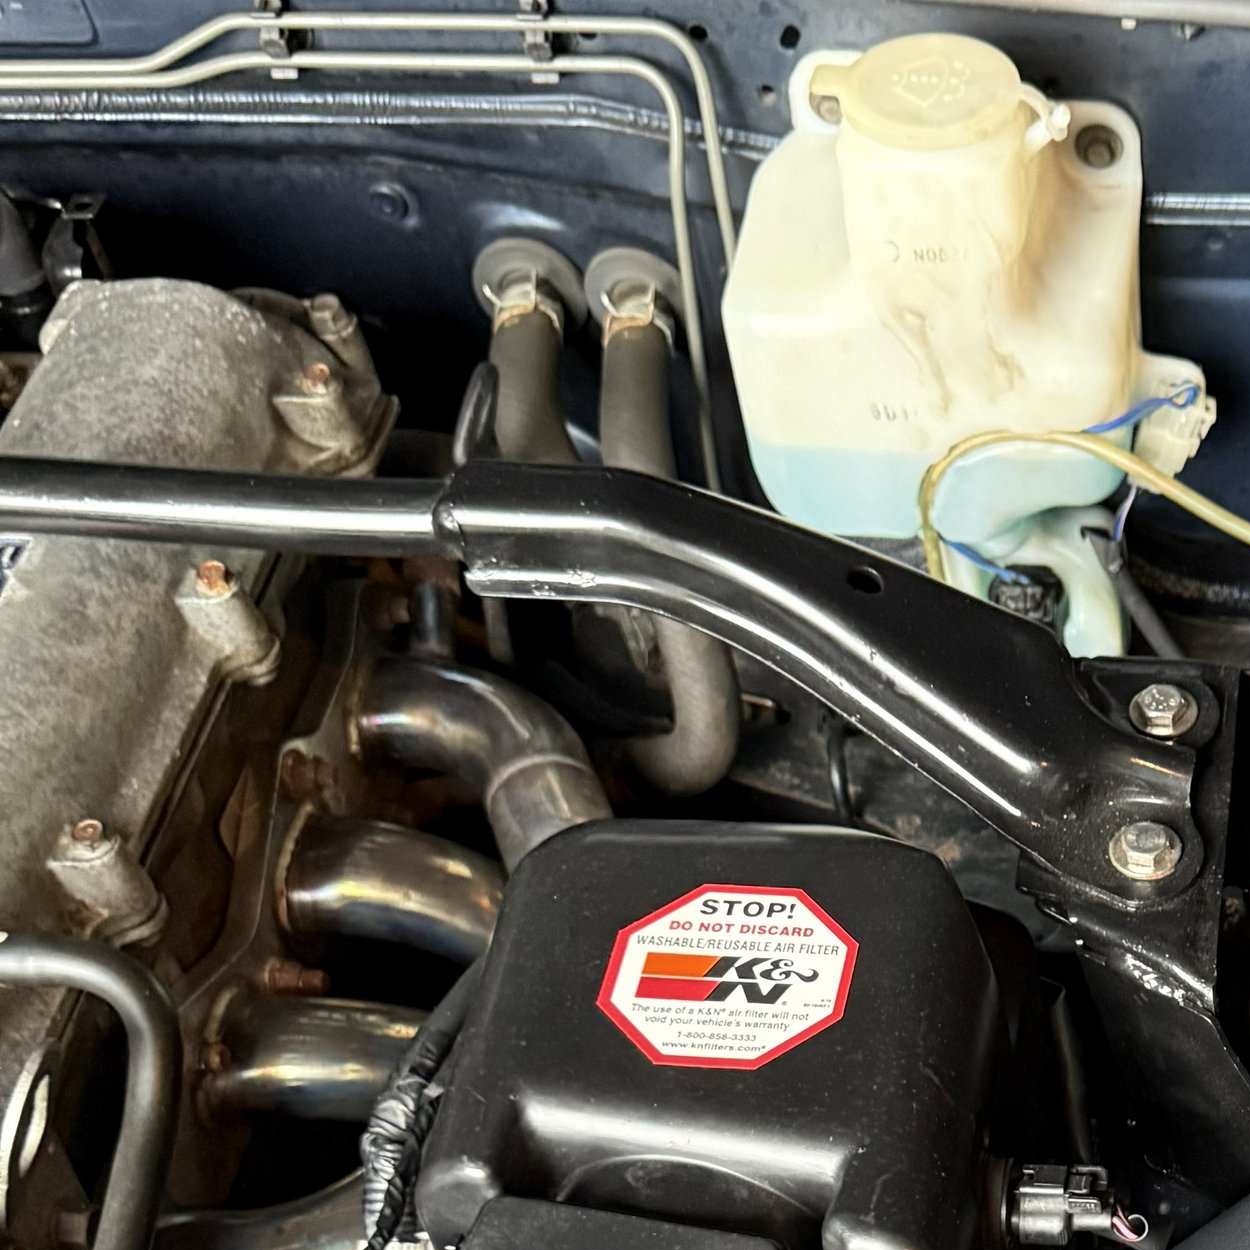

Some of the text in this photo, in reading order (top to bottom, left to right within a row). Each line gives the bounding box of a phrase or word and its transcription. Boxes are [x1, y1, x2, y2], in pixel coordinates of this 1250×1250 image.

[700, 899, 796, 919] STOP!
[669, 920, 815, 937] DO NOT DISCARD
[636, 935, 840, 956] WASHABLE/REUSABLE AIR FILTER
[632, 1003, 650, 1012] The
[675, 1006, 686, 1014] of
[728, 1009, 742, 1017] air
[745, 1009, 768, 1018] filter
[772, 1011, 789, 1019] will
[791, 1013, 809, 1021] not
[645, 1016, 790, 1032] void your vehicle's warranty
[677, 1031, 757, 1041] 1-800-858-3333
